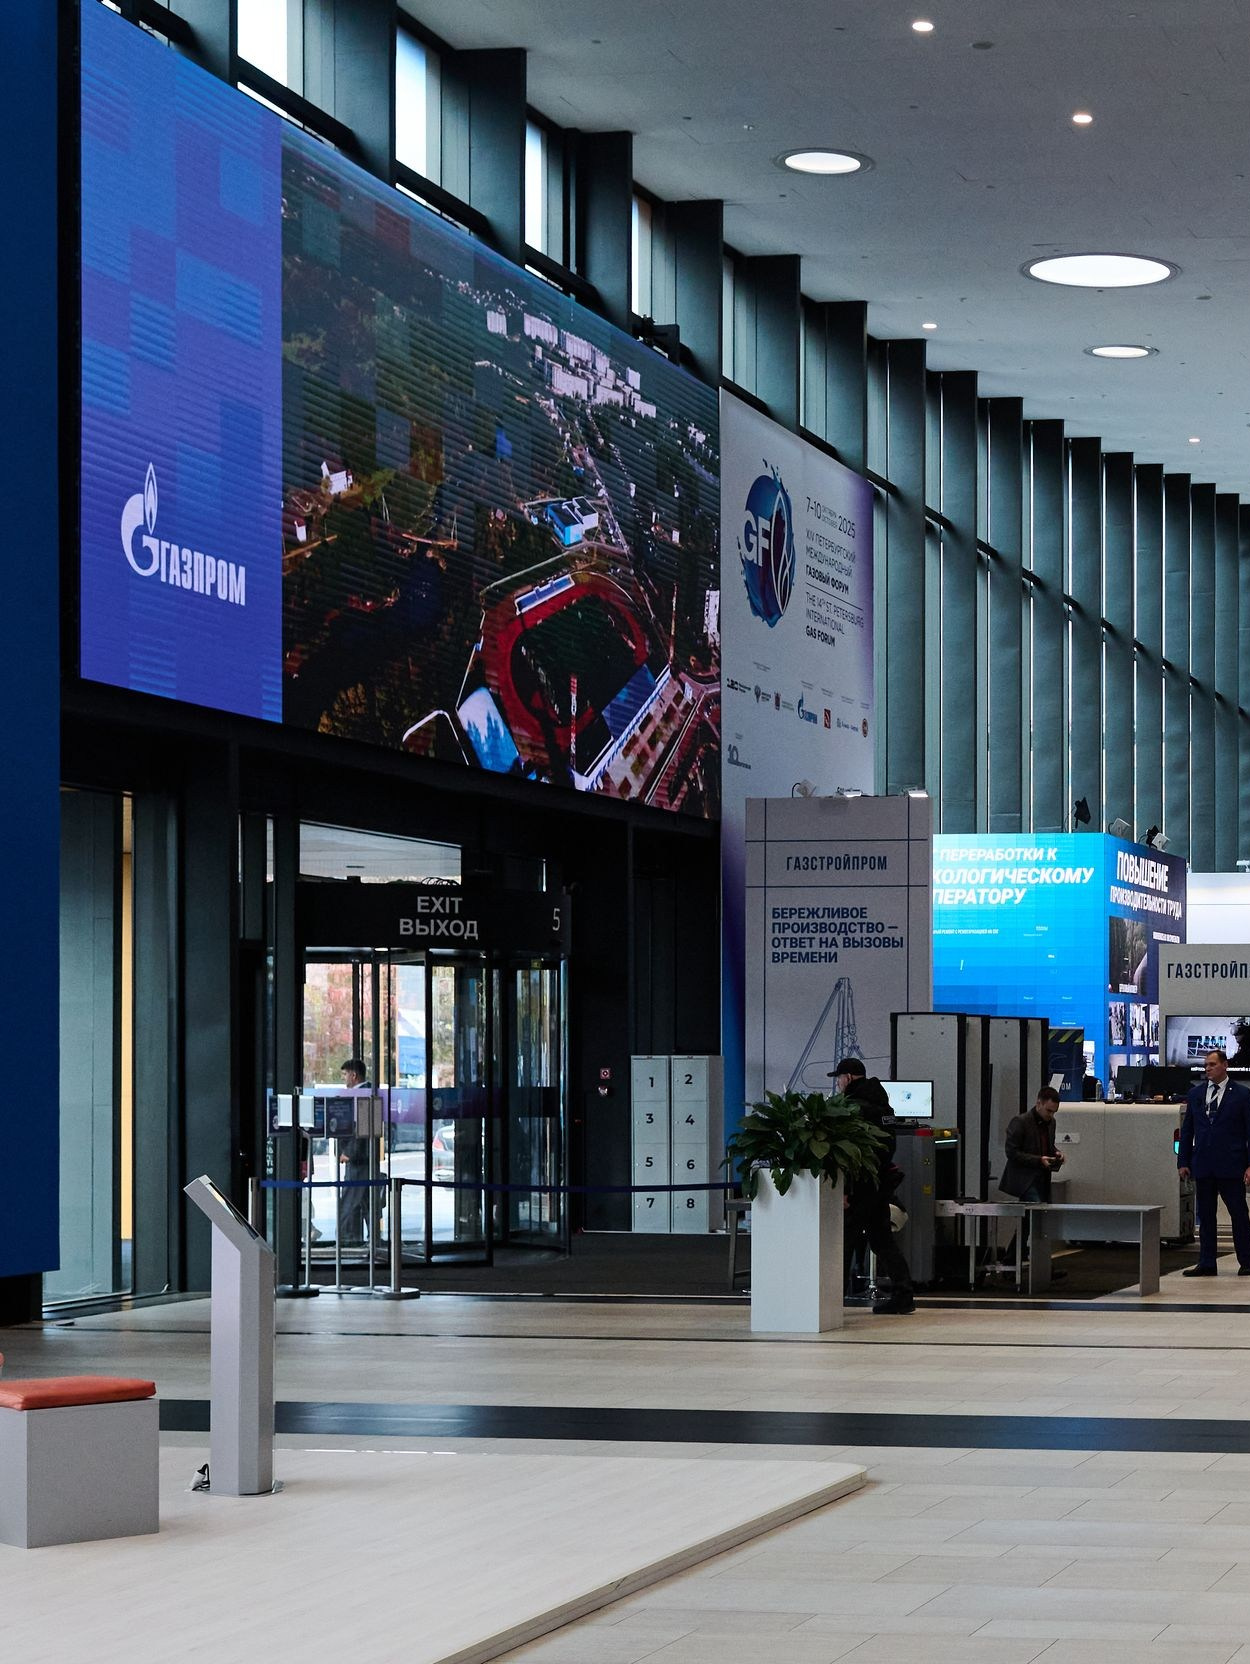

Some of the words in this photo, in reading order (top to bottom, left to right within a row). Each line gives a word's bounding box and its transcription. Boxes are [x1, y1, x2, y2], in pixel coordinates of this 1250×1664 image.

[838, 515, 856, 539] 2025
[744, 509, 771, 568] GF
[160, 541, 246, 606] ГАЗПРОМ
[806, 564, 830, 586] ГАЗОВЫЙ
[831, 577, 849, 595] ФОРУМ
[806, 608, 846, 635] INTERNATIONAL
[833, 605, 864, 629] PETERSBURG
[806, 625, 817, 640] GAS
[817, 630, 836, 647] FORUM
[786, 854, 887, 871] ГАЗСТРОЙПРОМ
[940, 848, 1044, 861] ПЕРЕРАБОТКИ
[1046, 848, 1058, 861] К
[933, 867, 1095, 884] КОЛОГИЧЕСКОМУ
[1117, 850, 1169, 893] ПОВЫШЕНИЕ
[416, 896, 463, 914] EXIT
[933, 888, 1028, 905] ПЕРАТОРУ
[1110, 885, 1167, 915] ПРОИЗВОДИТЕЛЬНОСТИ
[1167, 899, 1182, 921] ТРУДА
[552, 908, 561, 931] 5
[771, 907, 868, 919] БЕРЕЖЛИВОЕ
[399, 918, 479, 940] ВЫХОД
[771, 922, 885, 935] ПРОИЗВОДСТВО
[771, 936, 815, 949] ОТВЕТ
[819, 936, 839, 949] НА
[843, 936, 904, 949] ВЫЗОВЫ
[771, 951, 838, 964] ВРЕМЕНИ
[649, 1077, 654, 1088] 1
[684, 1074, 693, 1085] 2
[645, 1113, 654, 1124] 3
[685, 1114, 695, 1125] 4
[645, 1156, 654, 1168] 5
[686, 1159, 695, 1170] 6
[646, 1197, 655, 1208] 7
[686, 1198, 695, 1209] 8
